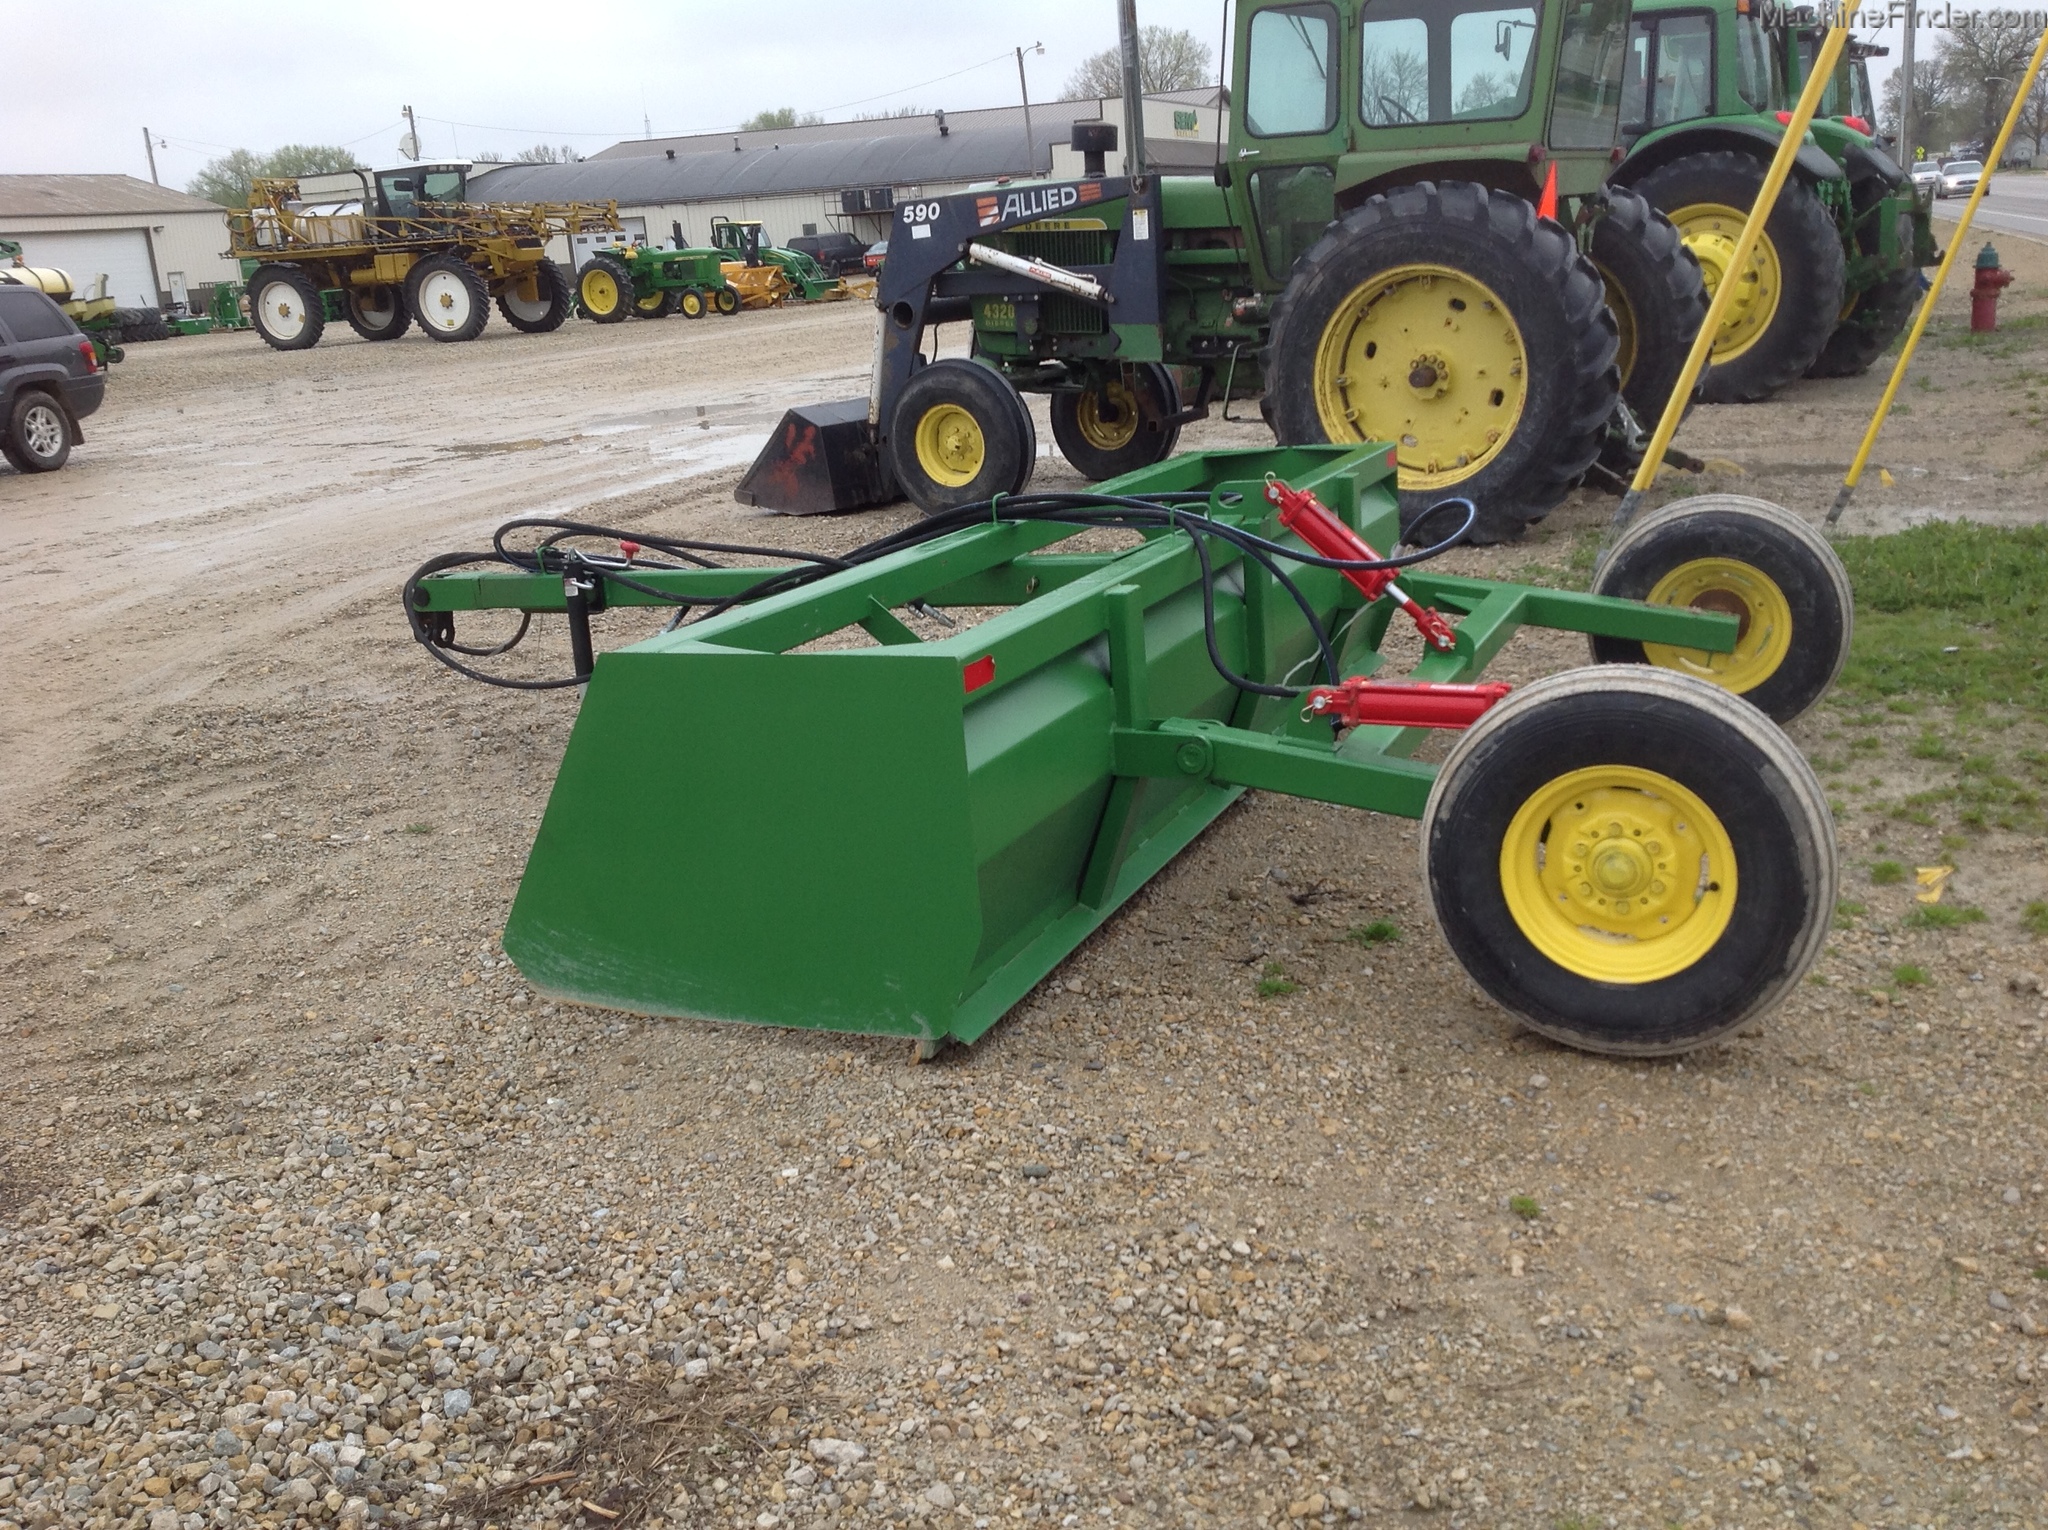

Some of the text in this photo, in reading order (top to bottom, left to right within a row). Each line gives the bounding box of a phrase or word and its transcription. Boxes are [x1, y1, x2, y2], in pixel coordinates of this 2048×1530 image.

[903, 202, 941, 224] 590
[1001, 186, 1077, 222] ALLIED
[1025, 221, 1070, 230] DEERE
[983, 303, 1014, 319] 4320
